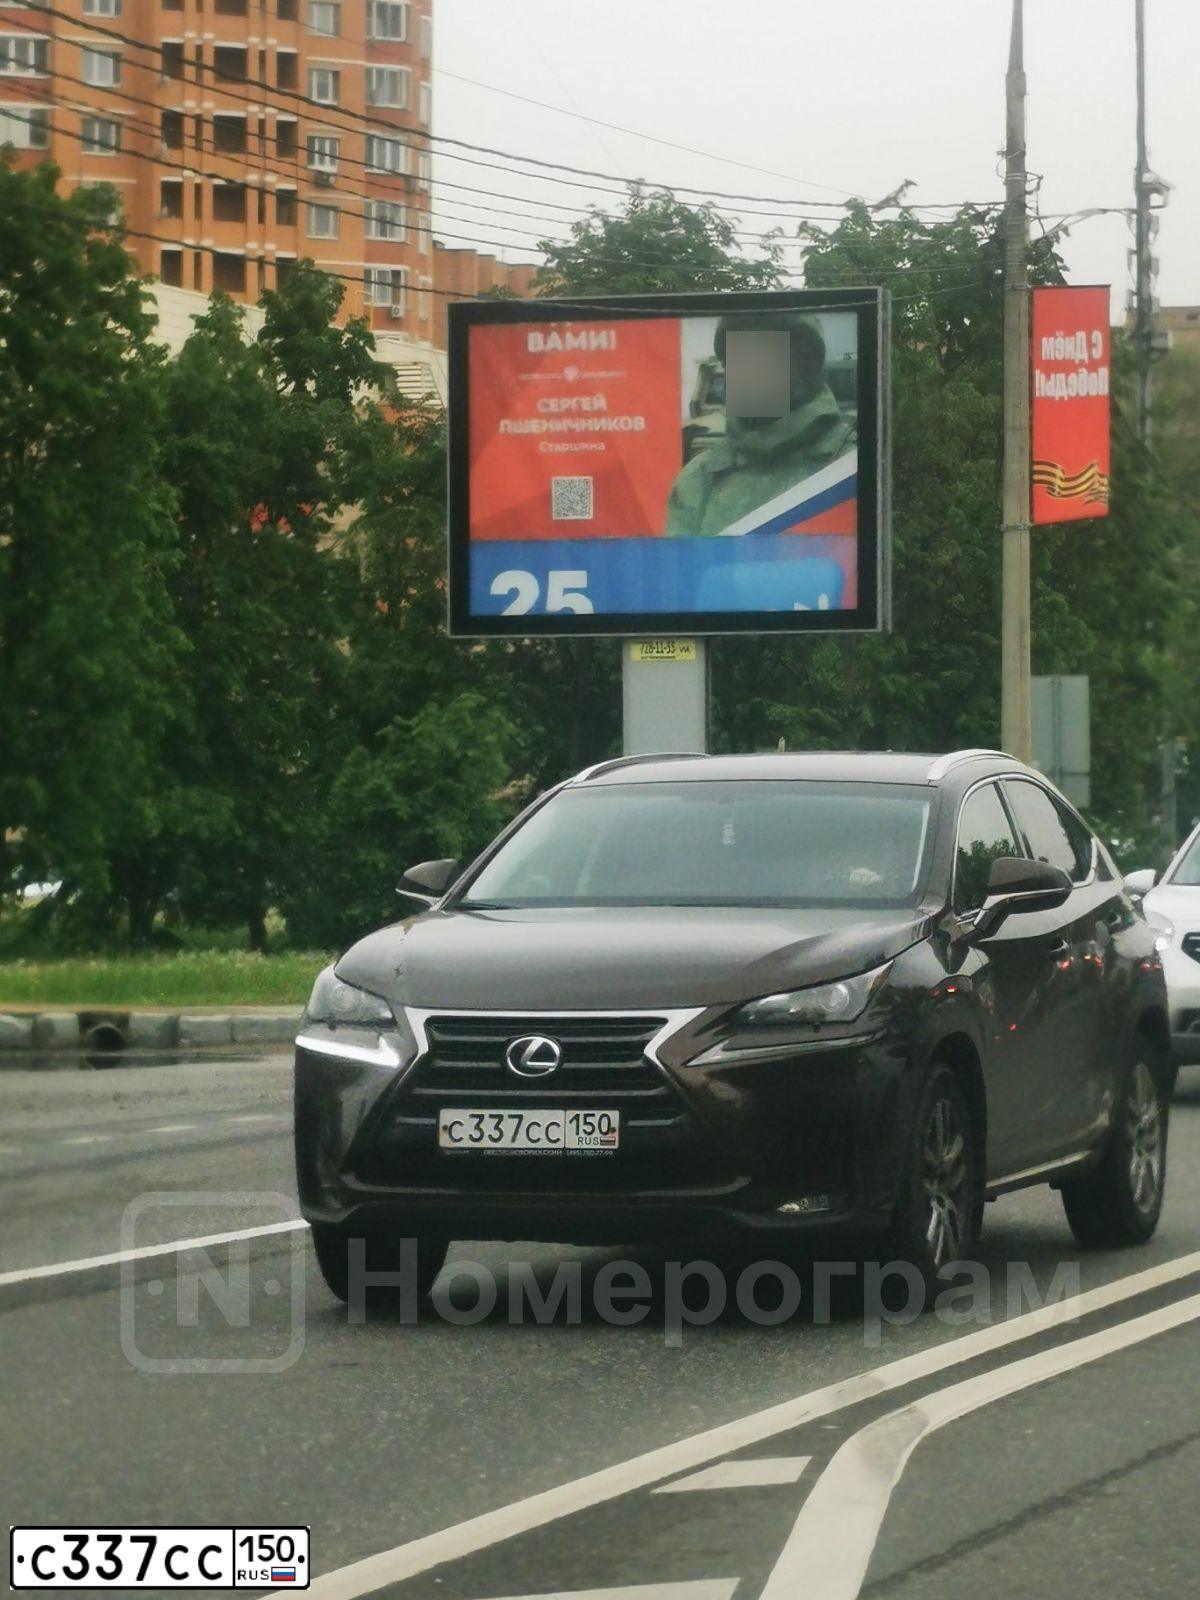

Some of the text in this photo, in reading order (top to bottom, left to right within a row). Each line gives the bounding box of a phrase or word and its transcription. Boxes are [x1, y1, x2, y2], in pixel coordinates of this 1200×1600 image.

[527, 330, 616, 352] ВАМИ!
[537, 394, 607, 413] СЕРГЕЙ
[539, 441, 606, 452] Старшина
[490, 570, 594, 616] 25
[569, 1113, 612, 1136] 150
[577, 1137, 599, 1146] RUS
